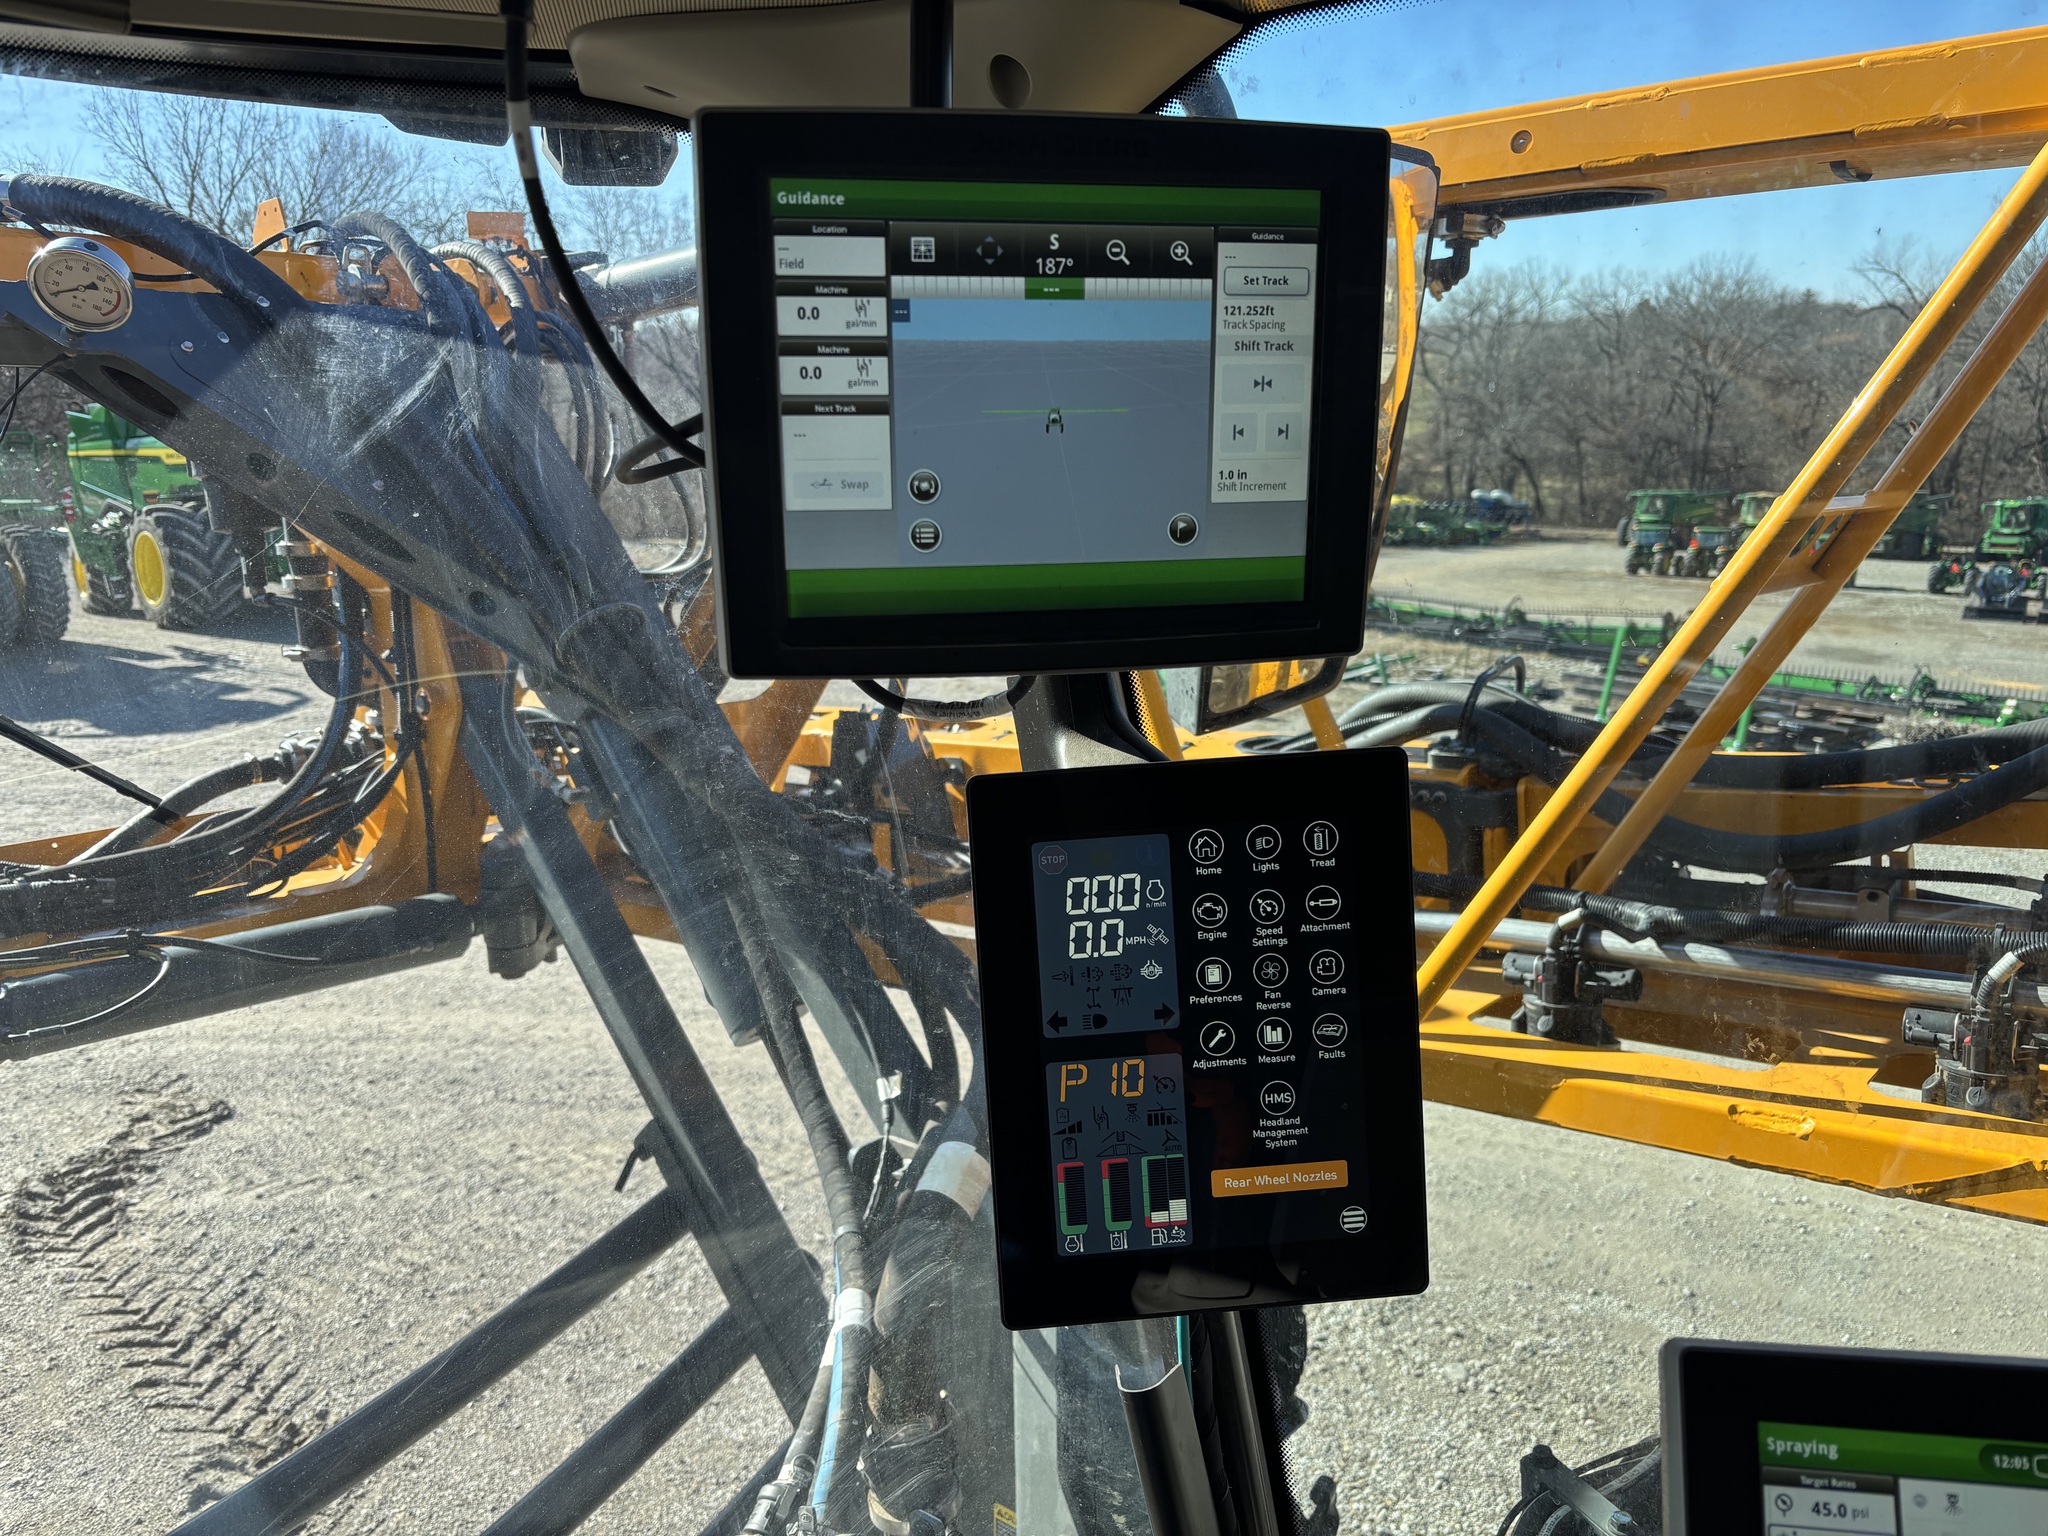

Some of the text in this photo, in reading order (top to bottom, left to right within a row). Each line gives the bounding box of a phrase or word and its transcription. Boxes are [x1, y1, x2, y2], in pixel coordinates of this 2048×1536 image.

[776, 191, 845, 206] Guidance
[812, 225, 847, 234] Location
[1049, 233, 1060, 250] S
[1252, 232, 1284, 241] Guidance
[778, 258, 804, 269] Field
[96, 274, 106, 283] 100
[1243, 276, 1289, 287] Set Track
[103, 286, 113, 294] 120
[815, 285, 848, 294] Machine
[102, 297, 112, 306] 140
[1223, 305, 1275, 317] 121.252ft
[797, 306, 877, 330] 0.0 gal/min
[1223, 319, 1286, 332] Track Spacing
[817, 345, 850, 354] Machine
[1234, 340, 1294, 351] Shift Track
[799, 366, 879, 389] 0.0 gal/min
[814, 404, 856, 413] Next Track
[1218, 469, 1248, 480] 1.0 in
[841, 479, 869, 491] Swap
[1217, 481, 1287, 492] Shift Increment
[1041, 855, 1065, 864] STOP
[1310, 858, 1336, 867] Tread
[1196, 866, 1222, 875] Home
[1252, 862, 1280, 873] Lights
[1066, 873, 1141, 916] 000
[1256, 926, 1283, 937] Speed
[1300, 922, 1351, 932] Attachment
[1069, 918, 1147, 959] 0.0 MPH
[1197, 930, 1227, 941] Engine
[1252, 937, 1288, 947] Settings
[1264, 991, 1281, 999] Fan
[1312, 987, 1346, 996] Camera
[1189, 994, 1243, 1004] Preferences
[1256, 1001, 1291, 1010] Reverse
[1258, 1054, 1296, 1063] Measure
[1318, 1050, 1346, 1059] Faults
[1192, 1057, 1247, 1070] Adjustments
[1060, 1058, 1145, 1103] P 10
[1265, 1092, 1292, 1104] HMS
[1259, 1116, 1301, 1127] Headland
[1252, 1126, 1309, 1138] Management
[1265, 1138, 1297, 1149] System
[1224, 1170, 1338, 1189] Rear Wheel Nozzles
[1766, 1436, 1839, 1460] Spraying
[1993, 1454, 2030, 1470] 12:05
[1800, 1475, 1857, 1490] Target Rates
[1811, 1501, 1870, 1521] 45.0 psi
